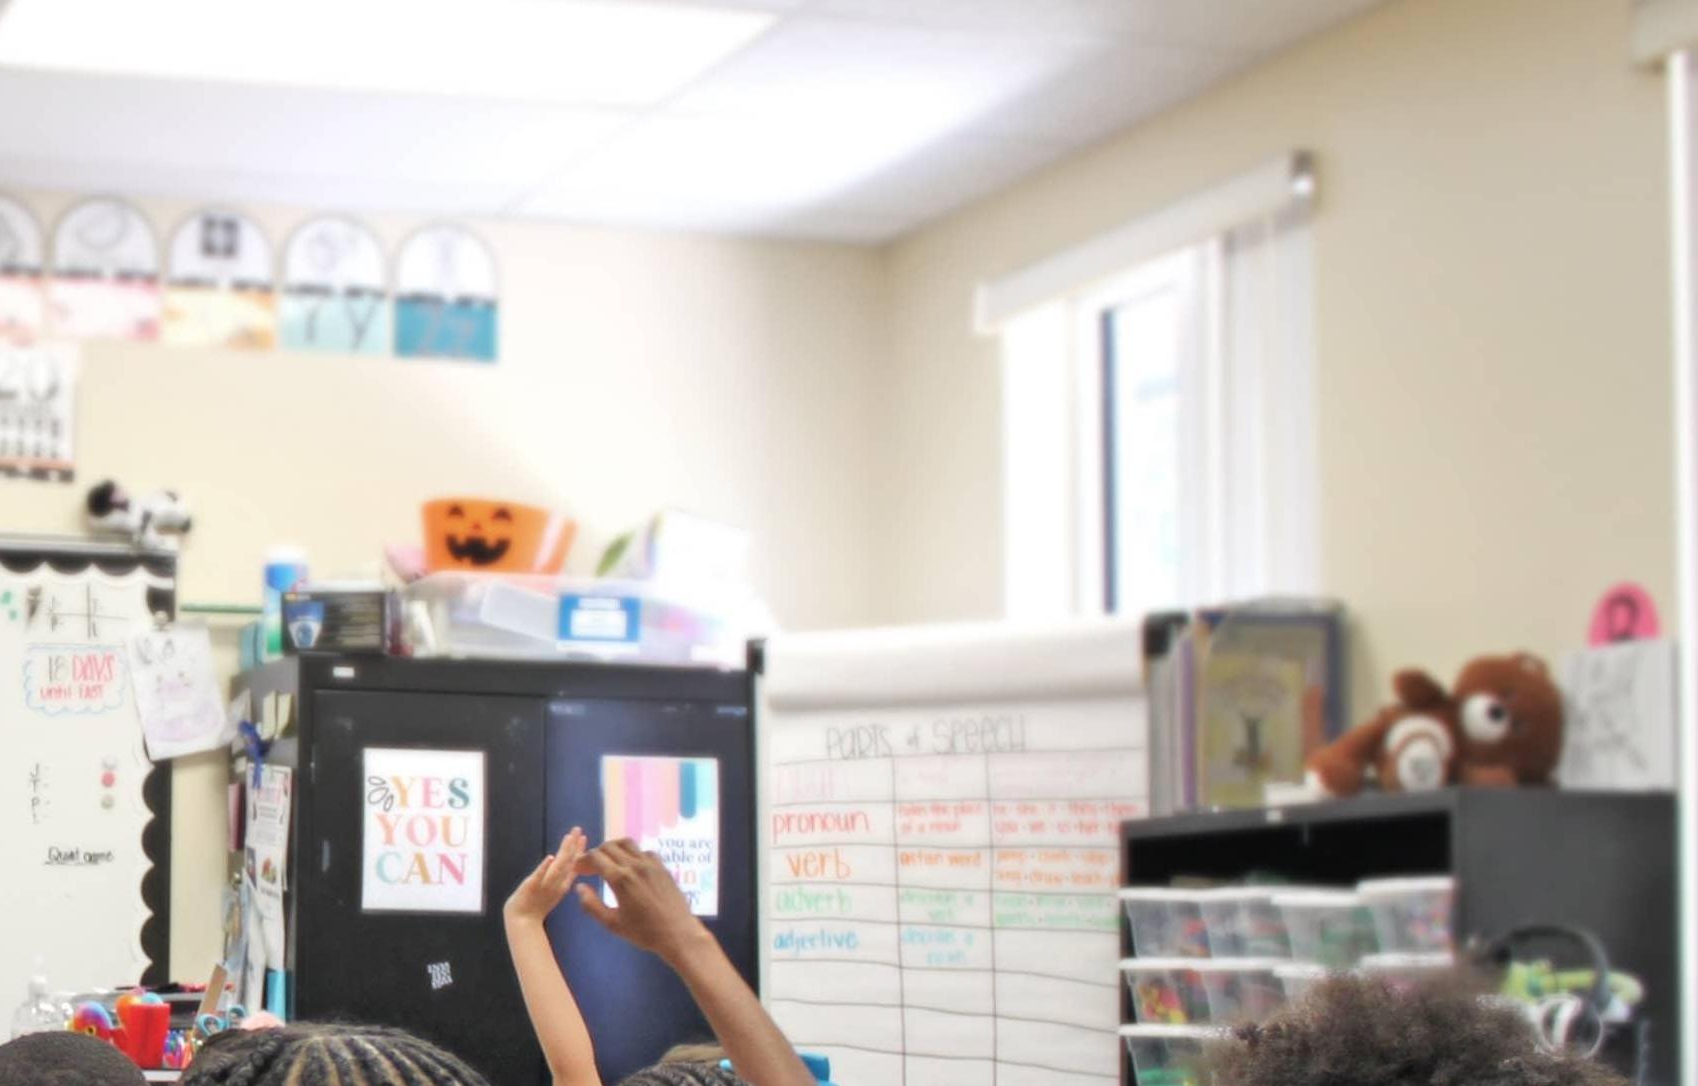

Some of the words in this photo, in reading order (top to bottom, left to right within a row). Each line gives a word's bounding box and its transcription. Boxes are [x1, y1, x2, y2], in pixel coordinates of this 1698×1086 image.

[72, 653, 115, 682] DAYS
[391, 774, 470, 810] YES
[375, 813, 470, 848] YOU
[773, 811, 870, 845] pronoun
[657, 838, 683, 852] you
[689, 838, 713, 850] are
[375, 851, 469, 886] CAN
[786, 848, 851, 880] verb
[774, 929, 860, 956] adjective
